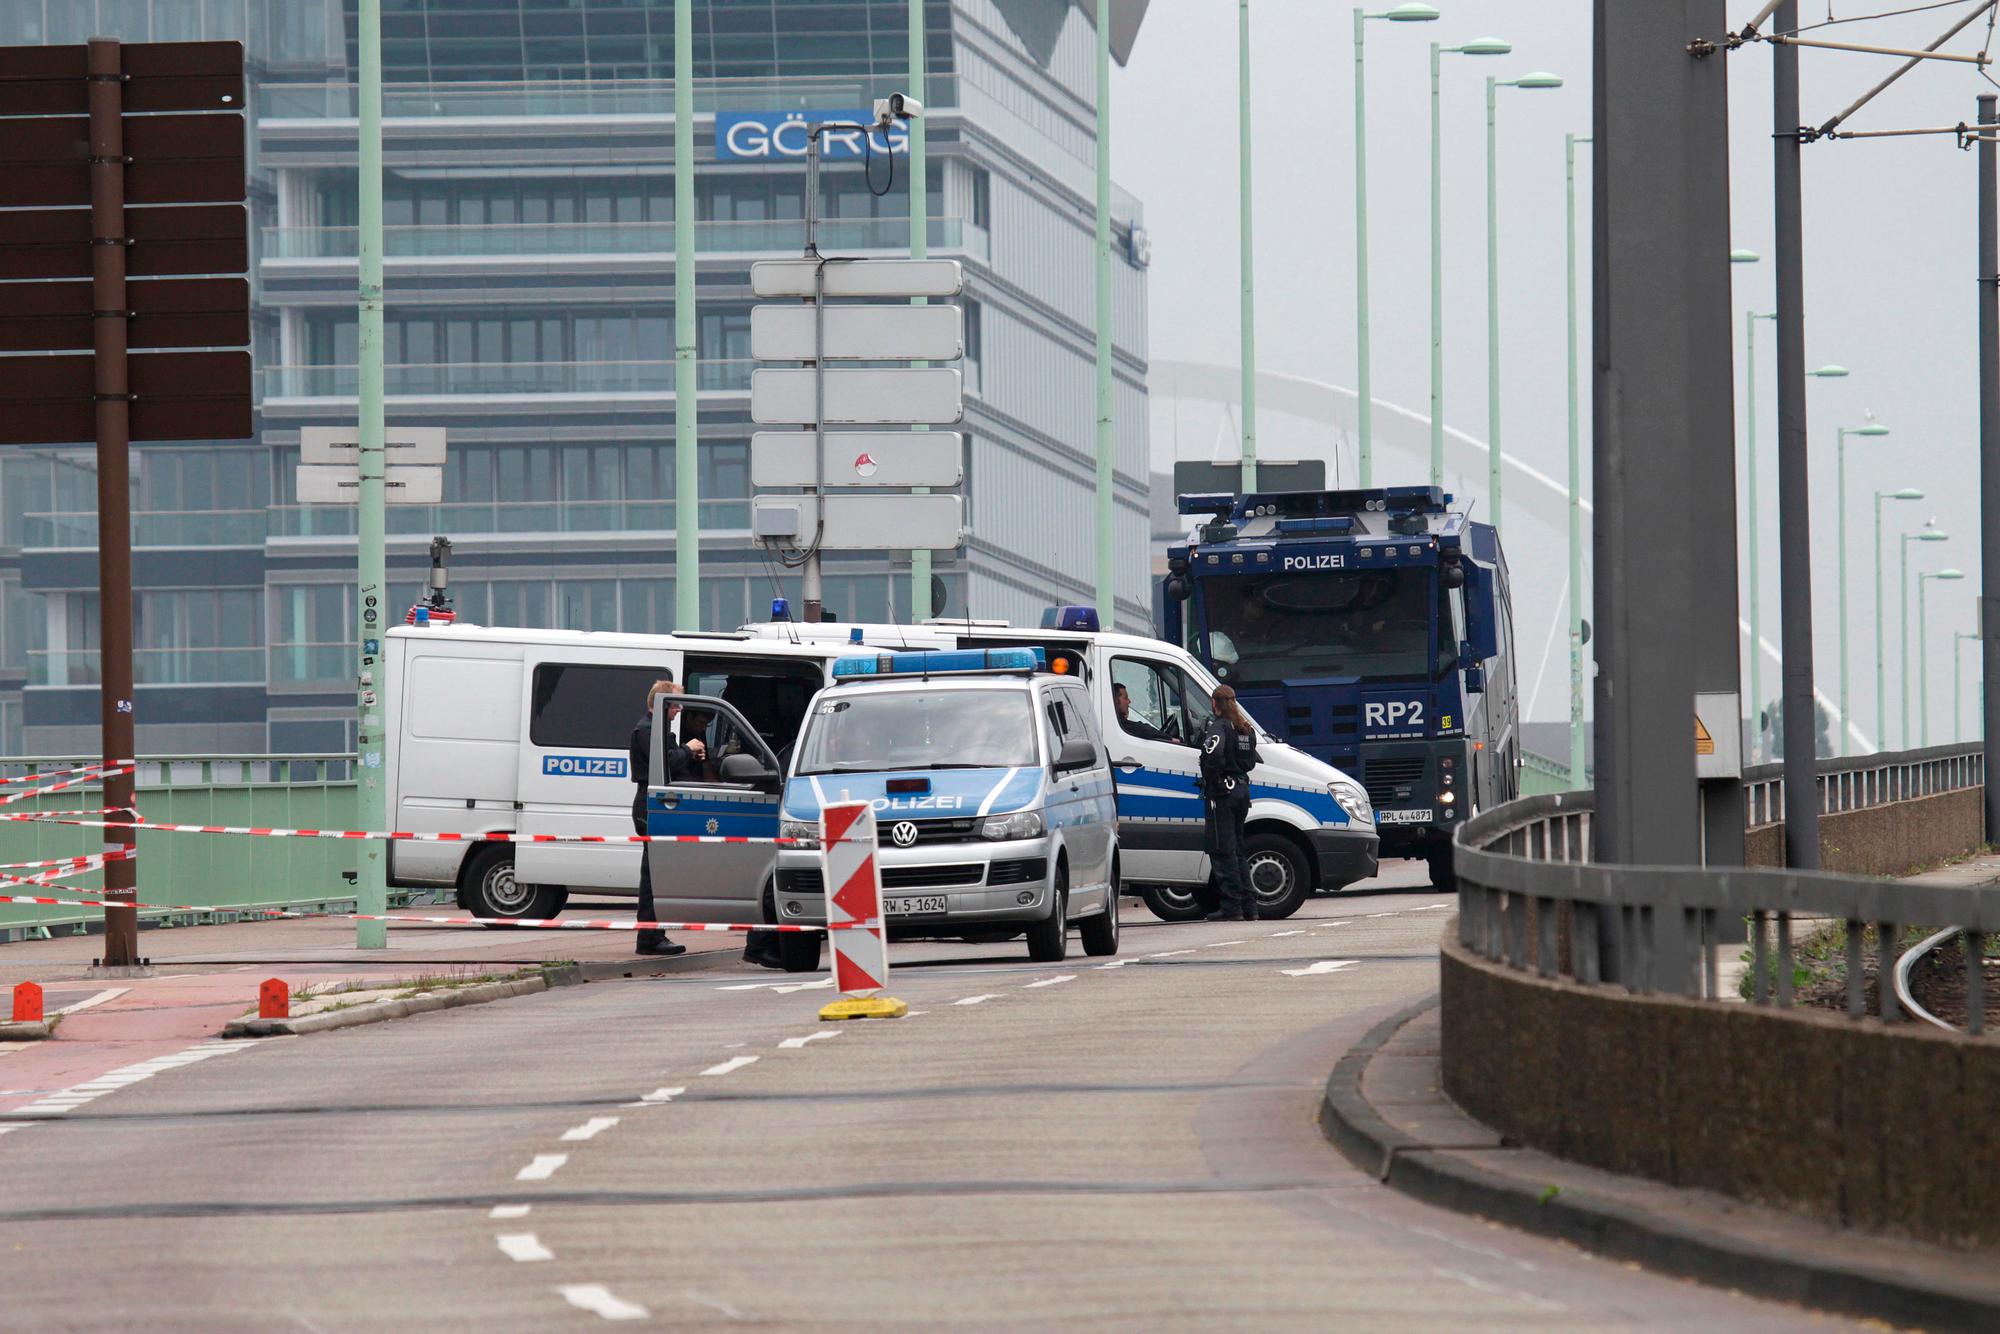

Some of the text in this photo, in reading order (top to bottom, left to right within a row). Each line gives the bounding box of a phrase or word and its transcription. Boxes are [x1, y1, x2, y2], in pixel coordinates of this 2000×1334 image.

[726, 113, 909, 157] GÖRG
[1284, 555, 1345, 570] POLIZEI
[1365, 701, 1424, 727] RP2
[1442, 717, 1451, 728] 39
[547, 758, 624, 775] POLIZEI
[871, 796, 963, 811] OLIZEI
